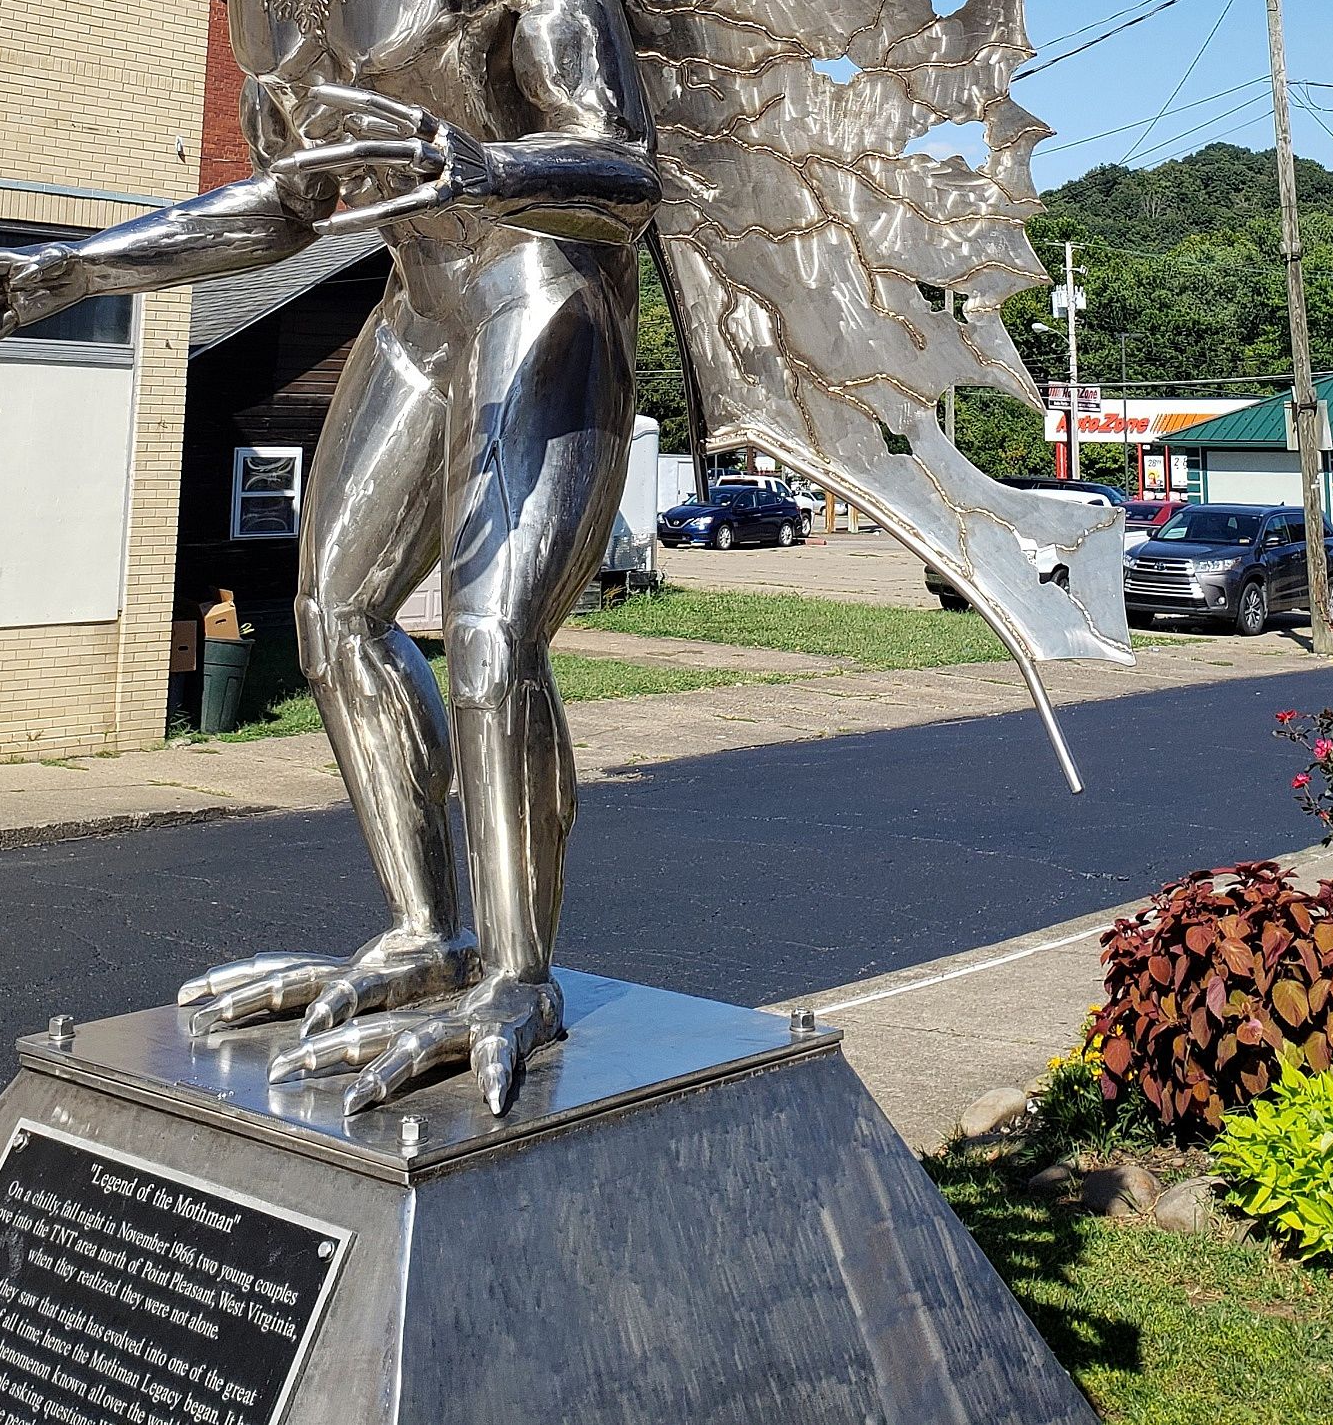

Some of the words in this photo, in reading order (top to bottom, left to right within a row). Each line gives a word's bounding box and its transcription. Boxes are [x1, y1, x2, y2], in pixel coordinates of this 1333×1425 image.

[1056, 413, 1150, 434] AtoZone
[8, 1180, 23, 1199] On
[23, 1190, 31, 1202] a
[31, 1190, 61, 1216] chilly,
[60, 1200, 81, 1220] fall
[77, 1208, 105, 1230] night
[102, 1216, 116, 1235] in
[117, 1221, 171, 1255] November
[168, 1241, 197, 1268] 1966,
[196, 1253, 218, 1275] two
[217, 1264, 254, 1292] young
[254, 1278, 298, 1305] couples
[91, 1163, 138, 1195] "Legend
[137, 1184, 154, 1202] of
[152, 1187, 173, 1210] the
[173, 1194, 242, 1233] Mothman"
[12, 1210, 33, 1231] into
[32, 1218, 49, 1238] the
[49, 1224, 78, 1249] TNT
[75, 1237, 98, 1257] area
[97, 1249, 128, 1271] north
[127, 1257, 143, 1275] of
[141, 1261, 171, 1286] Point
[169, 1271, 215, 1308] Pleasant,
[219, 1290, 246, 1316] West
[248, 1302, 297, 1342] Virginia,
[28, 1248, 53, 1270] when
[54, 1258, 78, 1283] they
[76, 1269, 122, 1297] realized
[119, 1284, 144, 1310] they
[144, 1297, 170, 1318] were
[169, 1307, 190, 1325] not
[187, 1312, 218, 1340] alone.
[2, 1312, 18, 1332] all
[17, 1318, 43, 1345] time;
[40, 1328, 72, 1357] hence
[70, 1343, 90, 1364] the
[88, 1350, 140, 1388] Mothman
[140, 1373, 183, 1411] Legacy
[223, 1410, 235, 1425] It
[18, 1290, 39, 1308] saw
[37, 1296, 60, 1319] that
[57, 1306, 87, 1330] night
[84, 1315, 105, 1338] has
[103, 1329, 146, 1356] evolved
[144, 1341, 167, 1366] into
[168, 1357, 189, 1376] one
[189, 1364, 206, 1382] of
[204, 1369, 224, 1391] the
[222, 1382, 257, 1406] great
[8, 1382, 44, 1412] asking
[51, 1365, 88, 1397] known
[87, 1384, 106, 1405] all
[103, 1395, 128, 1415] over
[127, 1402, 146, 1424] the
